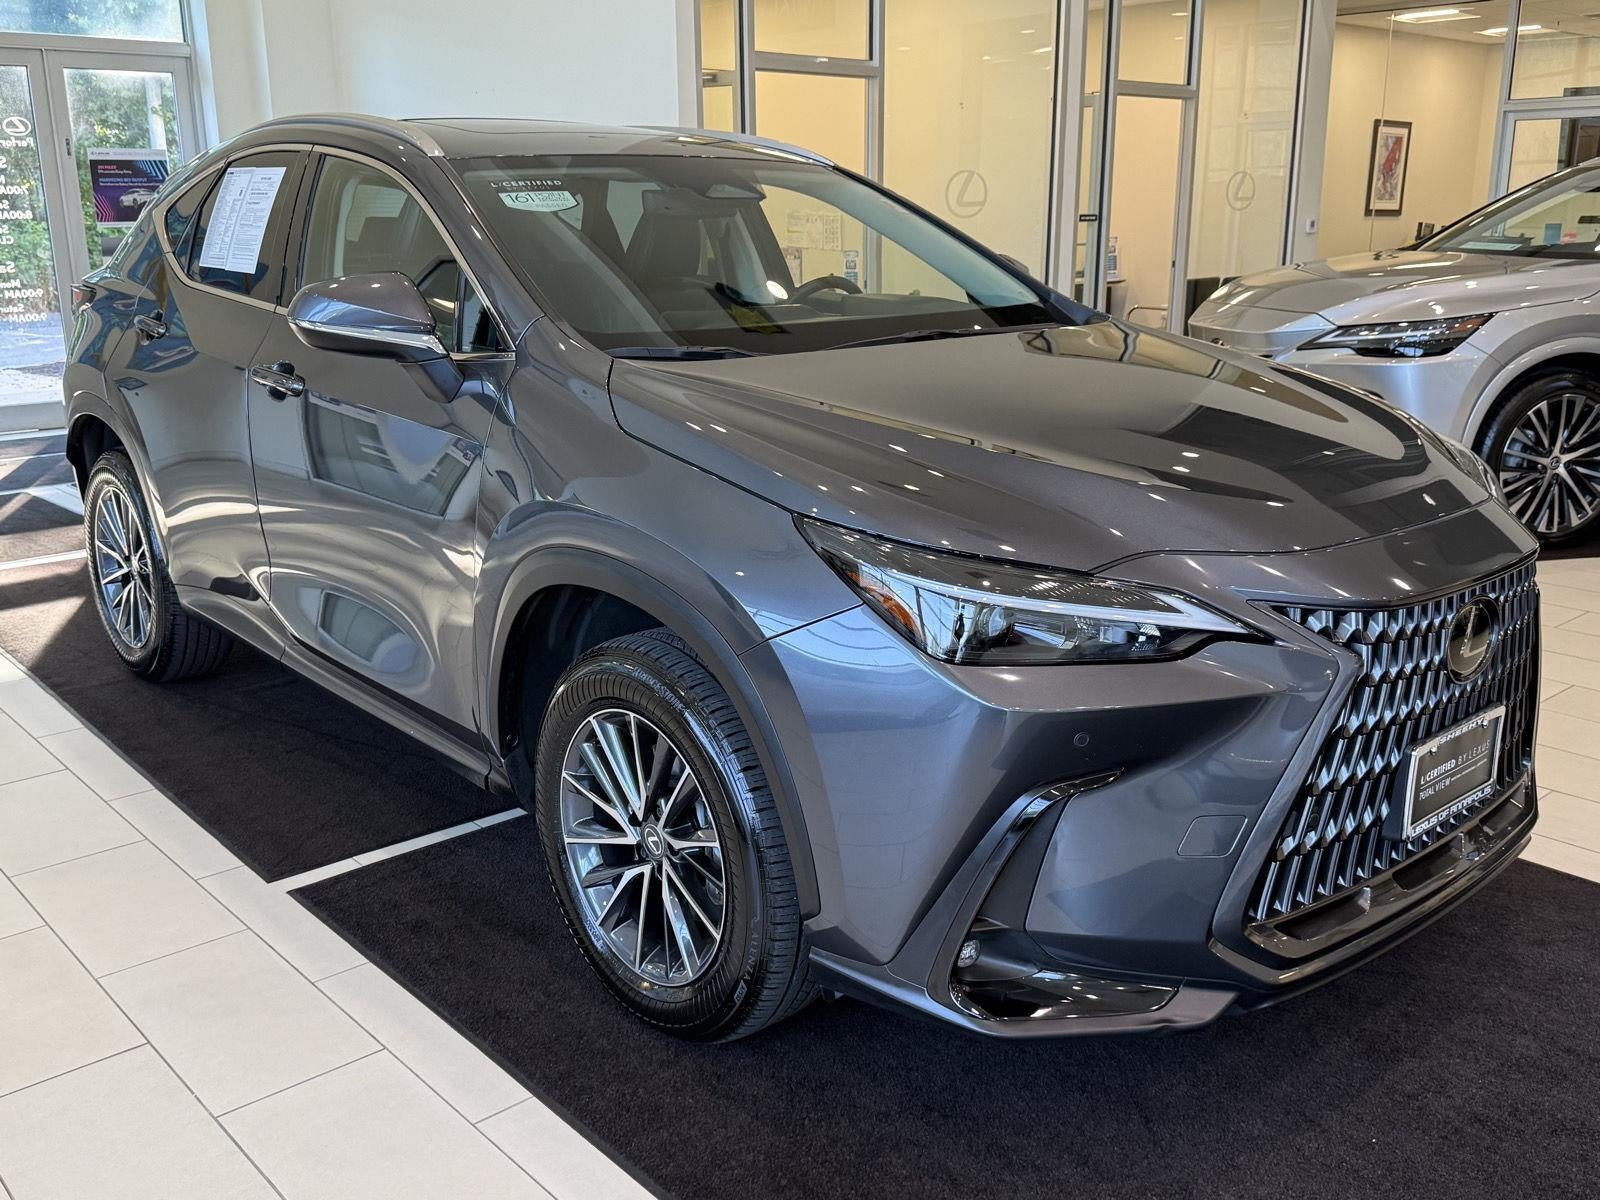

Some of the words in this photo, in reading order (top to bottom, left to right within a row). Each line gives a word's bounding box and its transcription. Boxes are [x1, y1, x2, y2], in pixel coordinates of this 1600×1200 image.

[505, 192, 536, 204] 161
[1457, 752, 1468, 765] BY
[1468, 739, 1491, 759] LEXUS
[1419, 787, 1435, 801] TOTAL
[1435, 777, 1451, 792] VIEW
[1411, 815, 1438, 837] LEXUS
[1438, 808, 1450, 821] OF
[1449, 785, 1493, 815] ANNAPOLIS
